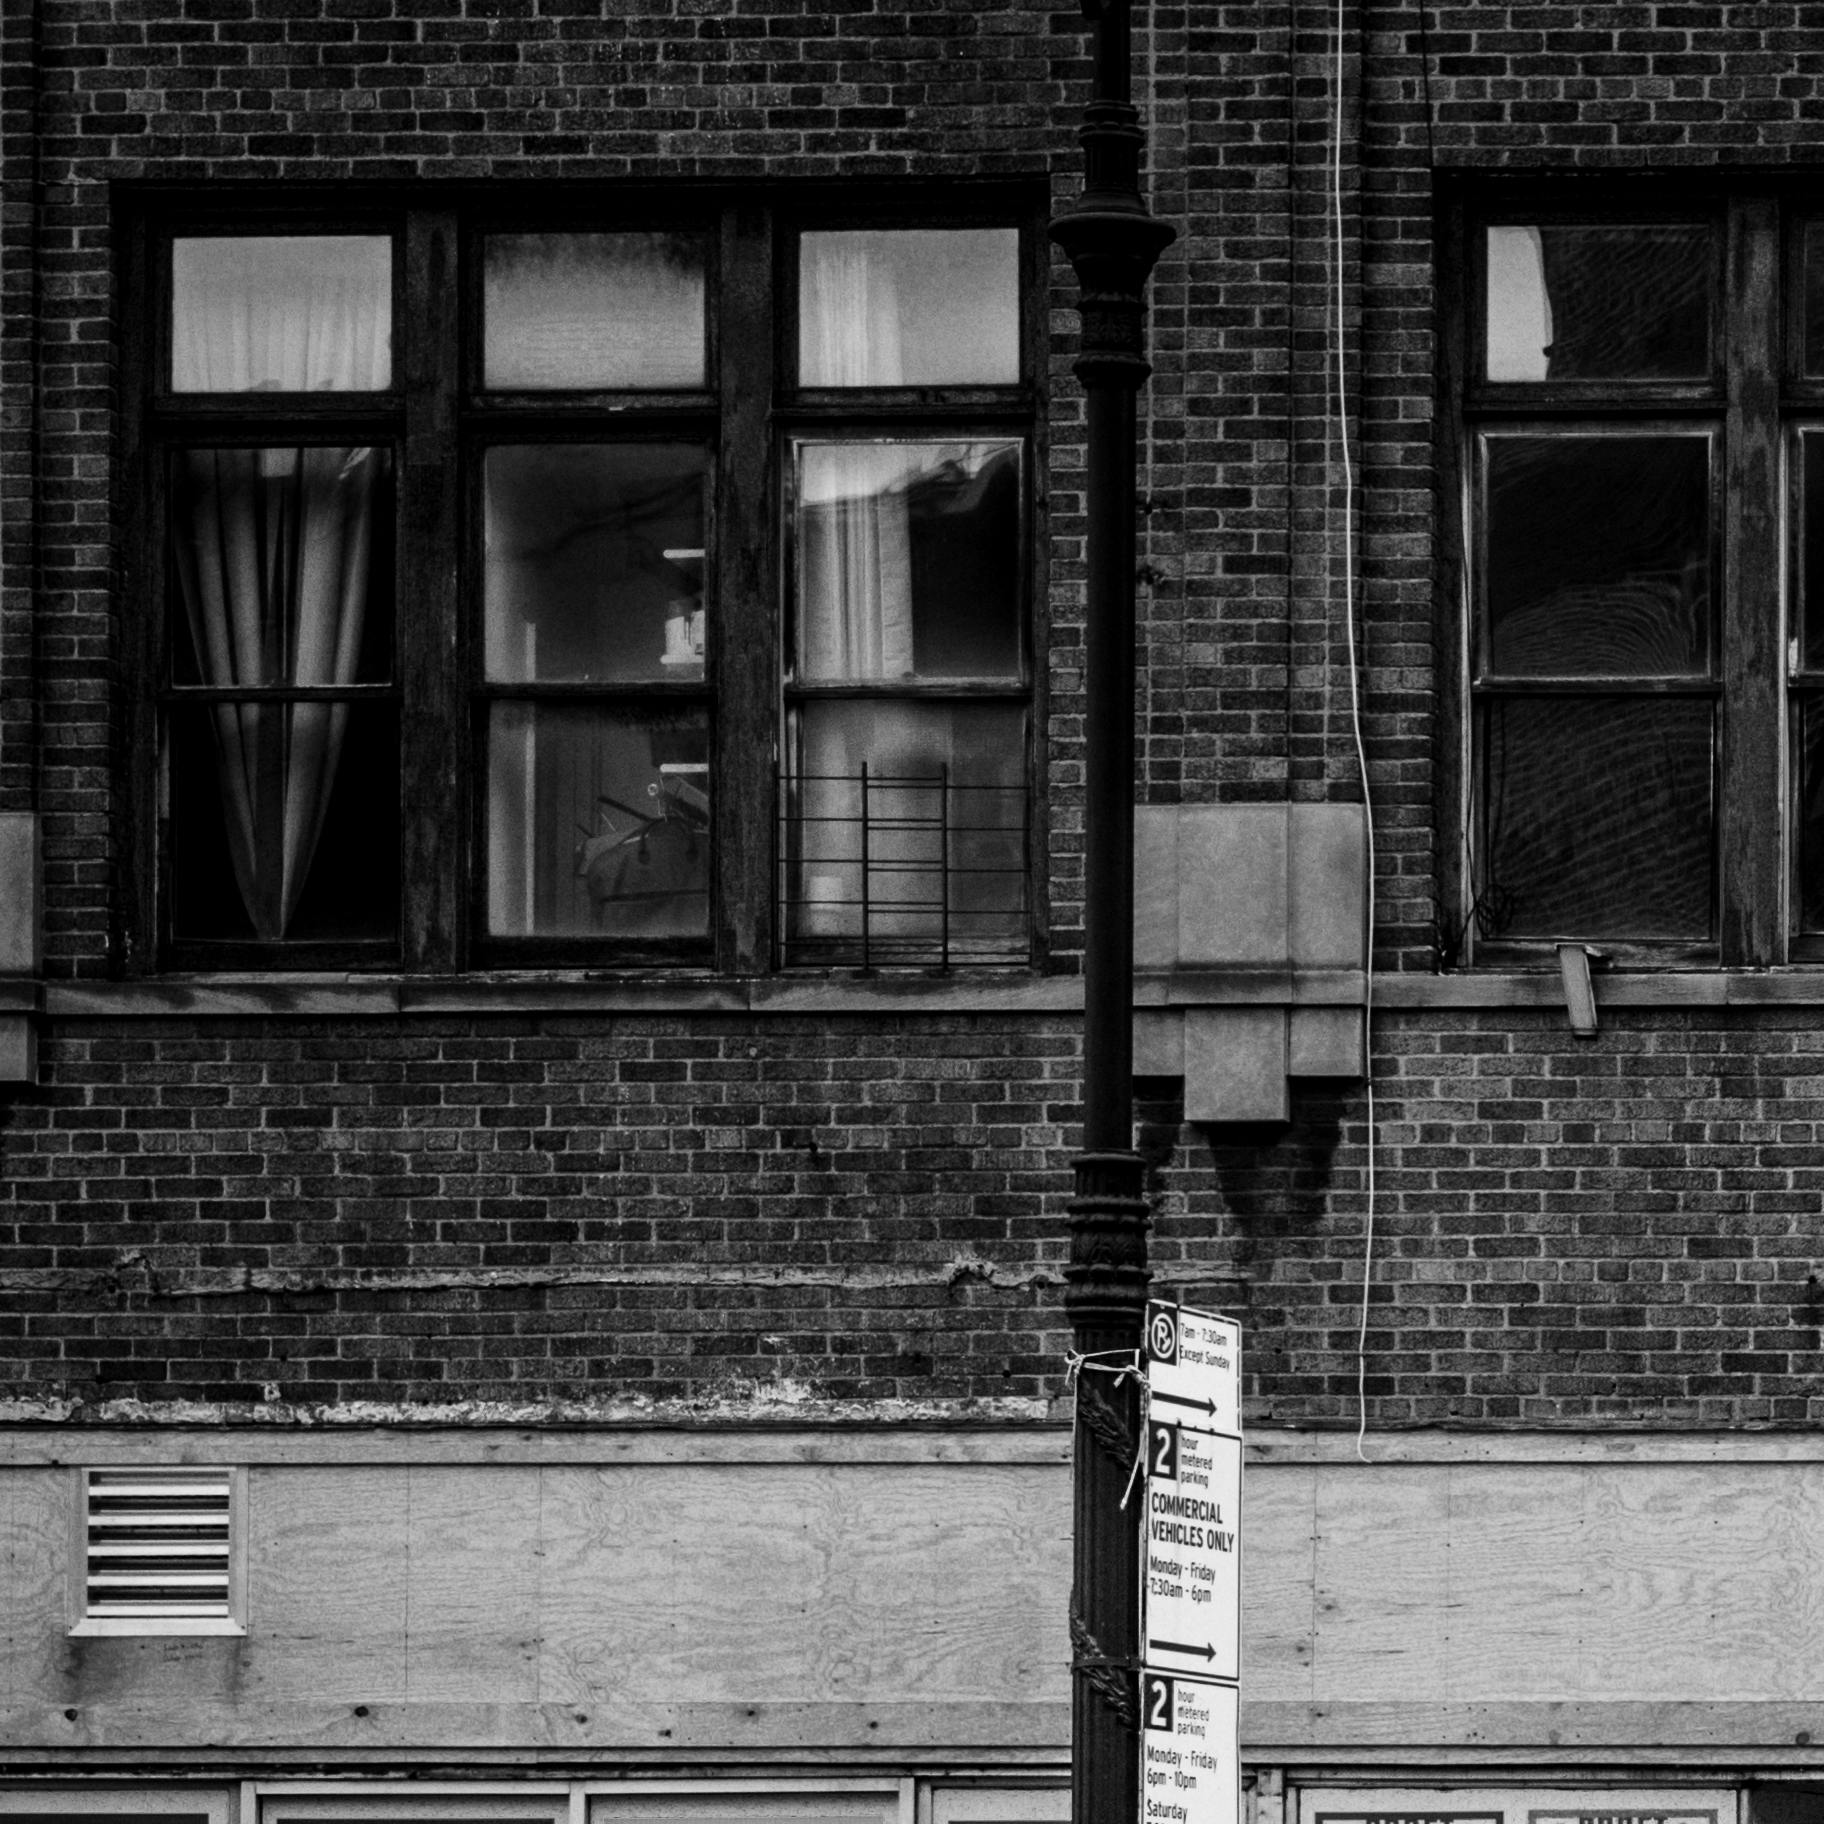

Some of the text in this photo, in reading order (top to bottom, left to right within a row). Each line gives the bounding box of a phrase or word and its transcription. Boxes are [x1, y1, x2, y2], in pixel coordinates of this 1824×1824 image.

[1180, 1345, 1230, 1372] Except Sunday
[1155, 1428, 1170, 1474] 2
[1181, 1436, 1198, 1450] hour
[1181, 1454, 1212, 1470] metered
[1181, 1471, 1208, 1489] parking
[1152, 1492, 1222, 1524] COMMERCIAL
[1152, 1520, 1234, 1552] VEHICLES ONLY
[1150, 1556, 1215, 1585] Monday Friday
[1150, 1577, 1211, 1604] 7:30am 6pm
[1151, 1680, 1167, 1727] 2
[1178, 1691, 1194, 1703] hour
[1178, 1706, 1209, 1721] metered
[1178, 1724, 1205, 1740] parking
[1147, 1744, 1217, 1771] Monday Friday
[1147, 1768, 1196, 1790] 6pm 10pm
[1147, 1800, 1187, 1824] Saturday
